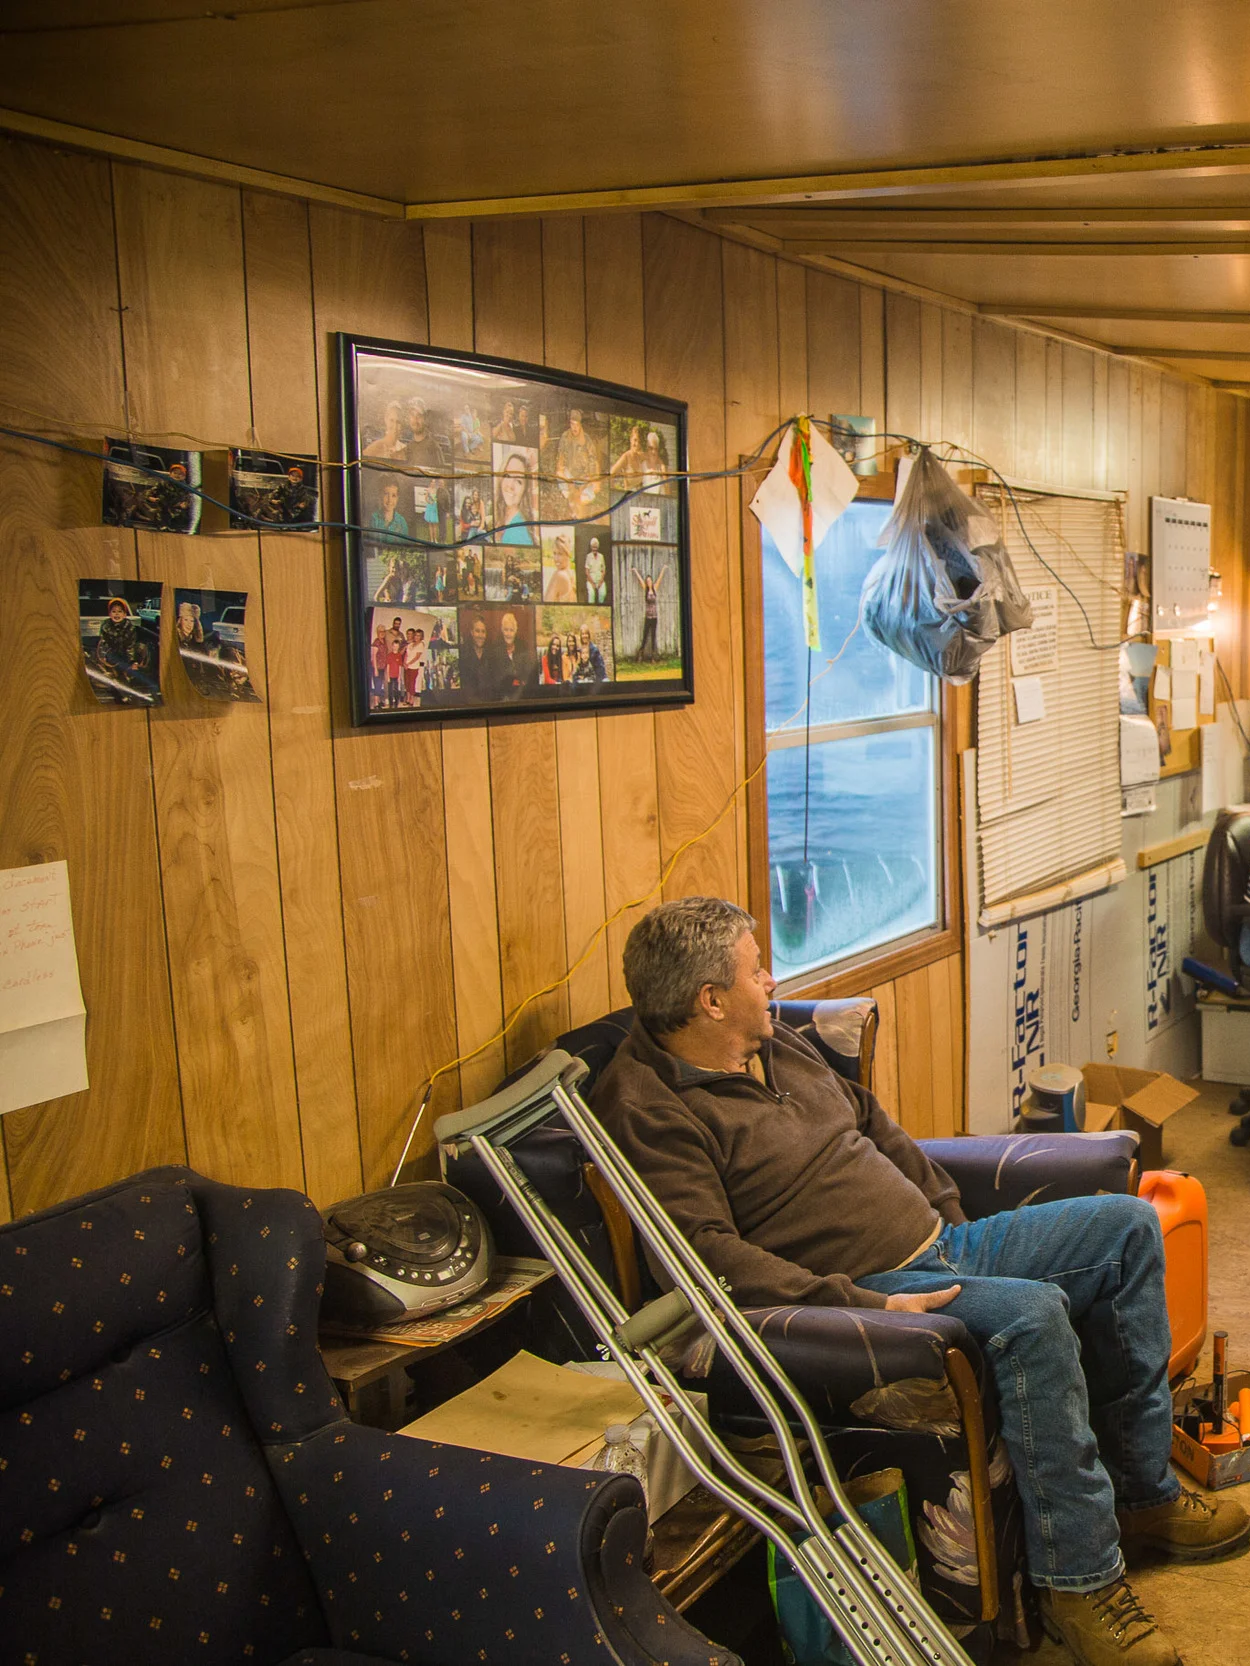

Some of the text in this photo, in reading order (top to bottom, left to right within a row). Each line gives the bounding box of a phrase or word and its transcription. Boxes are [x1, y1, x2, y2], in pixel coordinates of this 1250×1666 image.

[1026, 590, 1051, 602] OTICE
[1147, 868, 1158, 1032] R-Factor
[1011, 922, 1028, 1118] R-Factor
[1026, 988, 1040, 1056] NR
